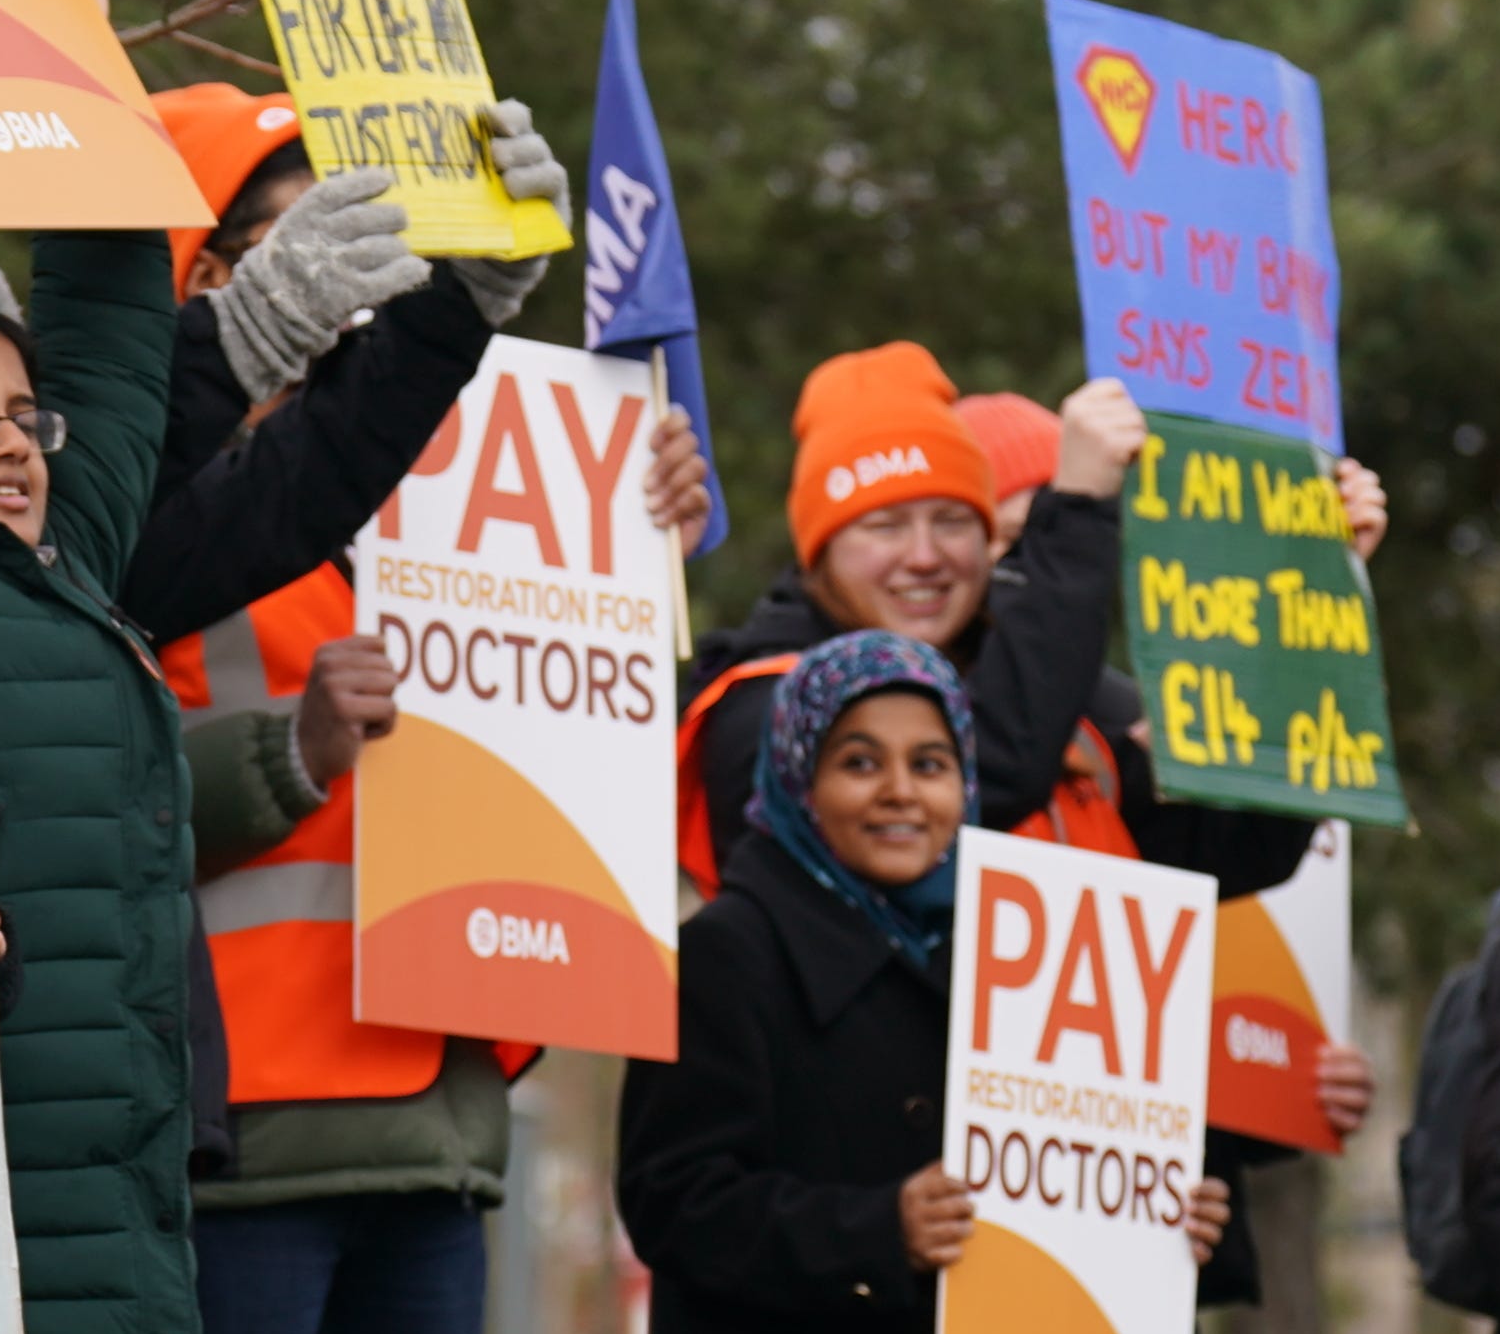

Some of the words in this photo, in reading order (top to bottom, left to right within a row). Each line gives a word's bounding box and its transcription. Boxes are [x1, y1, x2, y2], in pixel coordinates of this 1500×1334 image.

[10, 111, 79, 150] BMA
[1089, 198, 1166, 274] BUT
[1188, 225, 1240, 293] MY
[1117, 310, 1213, 391] SAYS
[854, 446, 931, 483] BMA
[1133, 434, 1168, 518] I
[1180, 443, 1242, 522] AM
[377, 555, 587, 625] RESTORATION
[596, 592, 655, 637] FOR
[379, 614, 656, 726] DOCTORS
[501, 916, 569, 965] BMA
[972, 867, 1196, 1084] PAY
[1248, 1024, 1290, 1068] BMA
[967, 1067, 1138, 1131] RESTORATION
[1145, 1100, 1190, 1143] FOR
[966, 1125, 1188, 1228] DOCTORS
